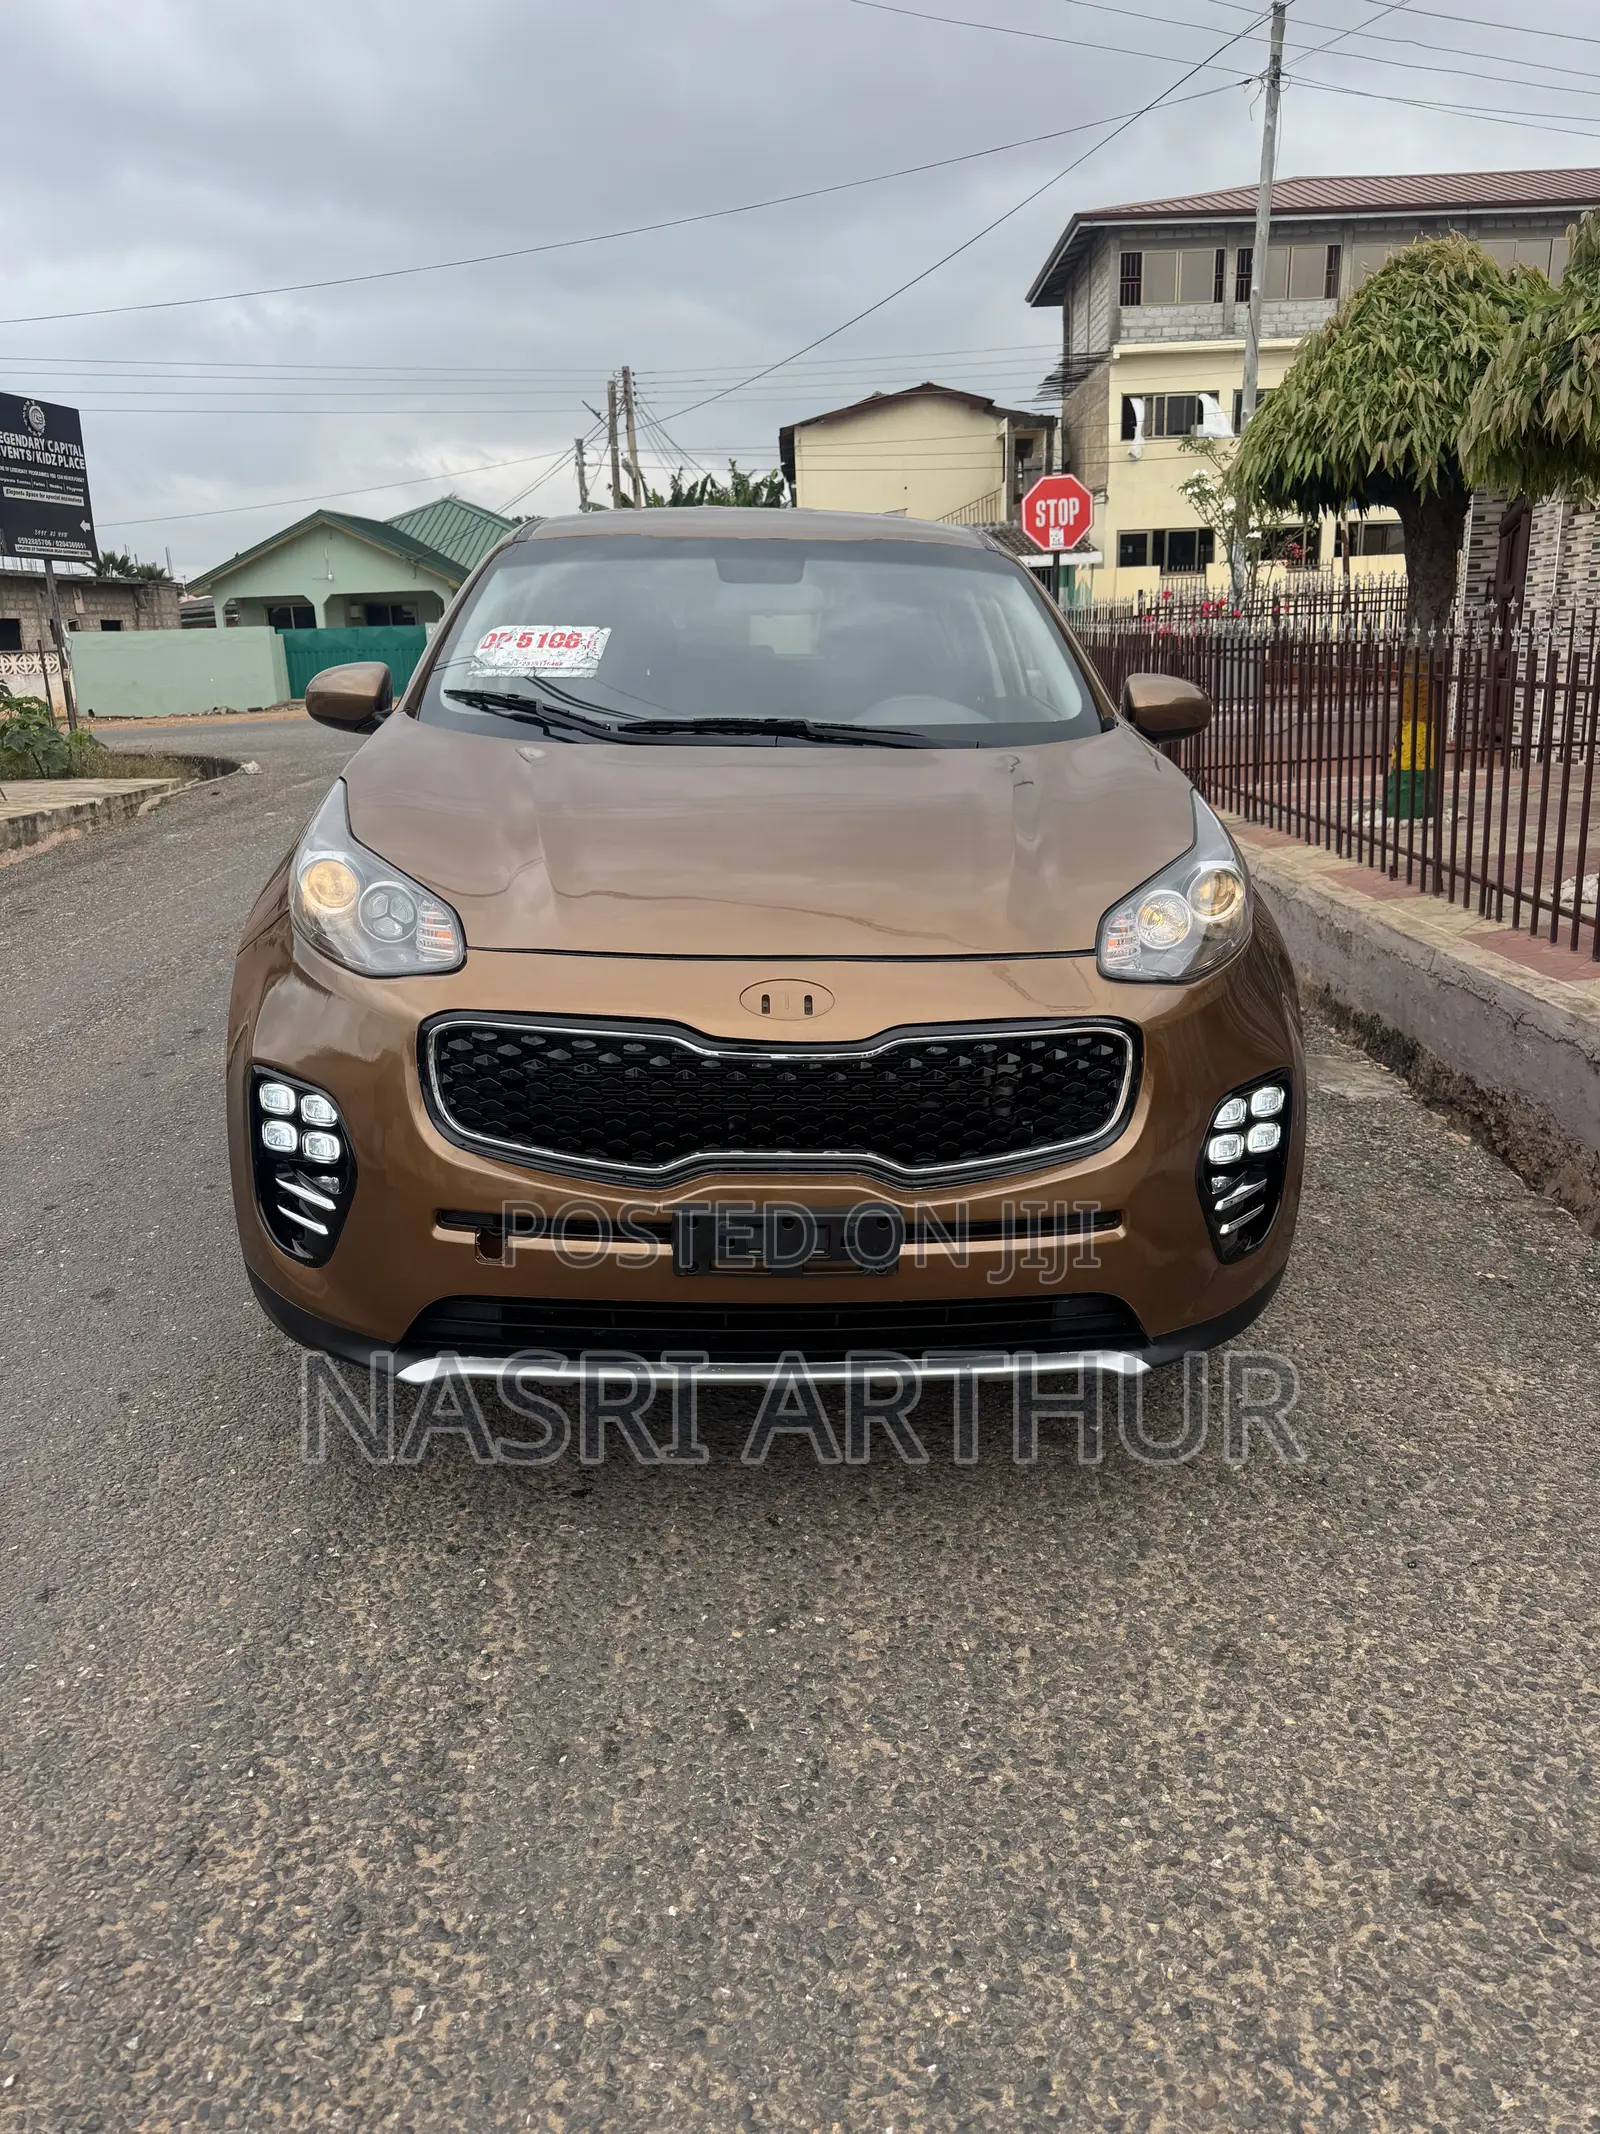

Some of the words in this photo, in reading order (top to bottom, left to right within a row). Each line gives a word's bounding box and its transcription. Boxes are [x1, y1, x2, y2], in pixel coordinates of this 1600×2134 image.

[0, 445, 58, 466] VENTS/KIDZ
[58, 455, 86, 470] PLACE
[47, 440, 84, 457] CAPITAL
[1035, 497, 1080, 528] STOP
